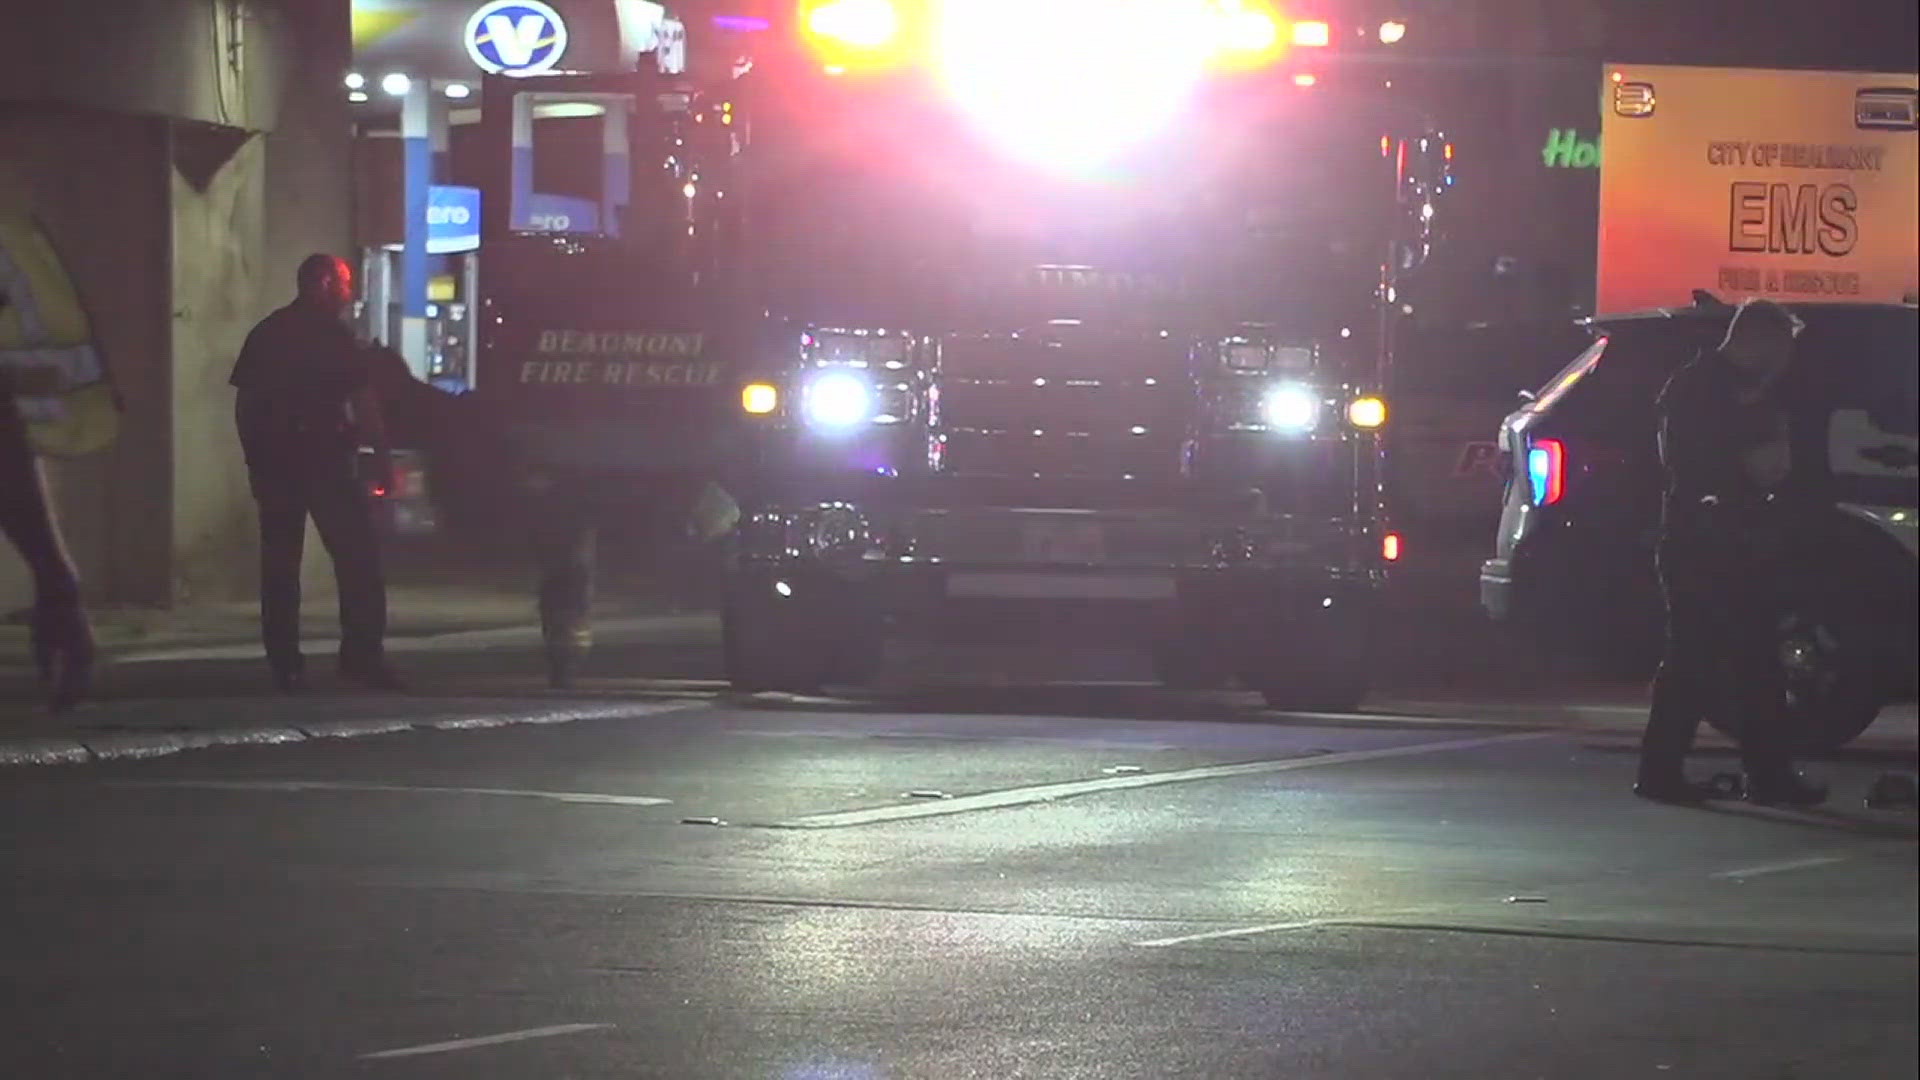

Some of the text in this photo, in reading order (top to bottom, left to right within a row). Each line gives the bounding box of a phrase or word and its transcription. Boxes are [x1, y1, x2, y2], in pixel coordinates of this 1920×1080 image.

[484, 14, 546, 65] V
[1707, 141, 1750, 166] CITY
[1752, 142, 1778, 168] OF
[1730, 181, 1858, 257] EMS
[538, 329, 705, 354] BEAUMONT
[520, 360, 727, 385] FIRE RESCUE
